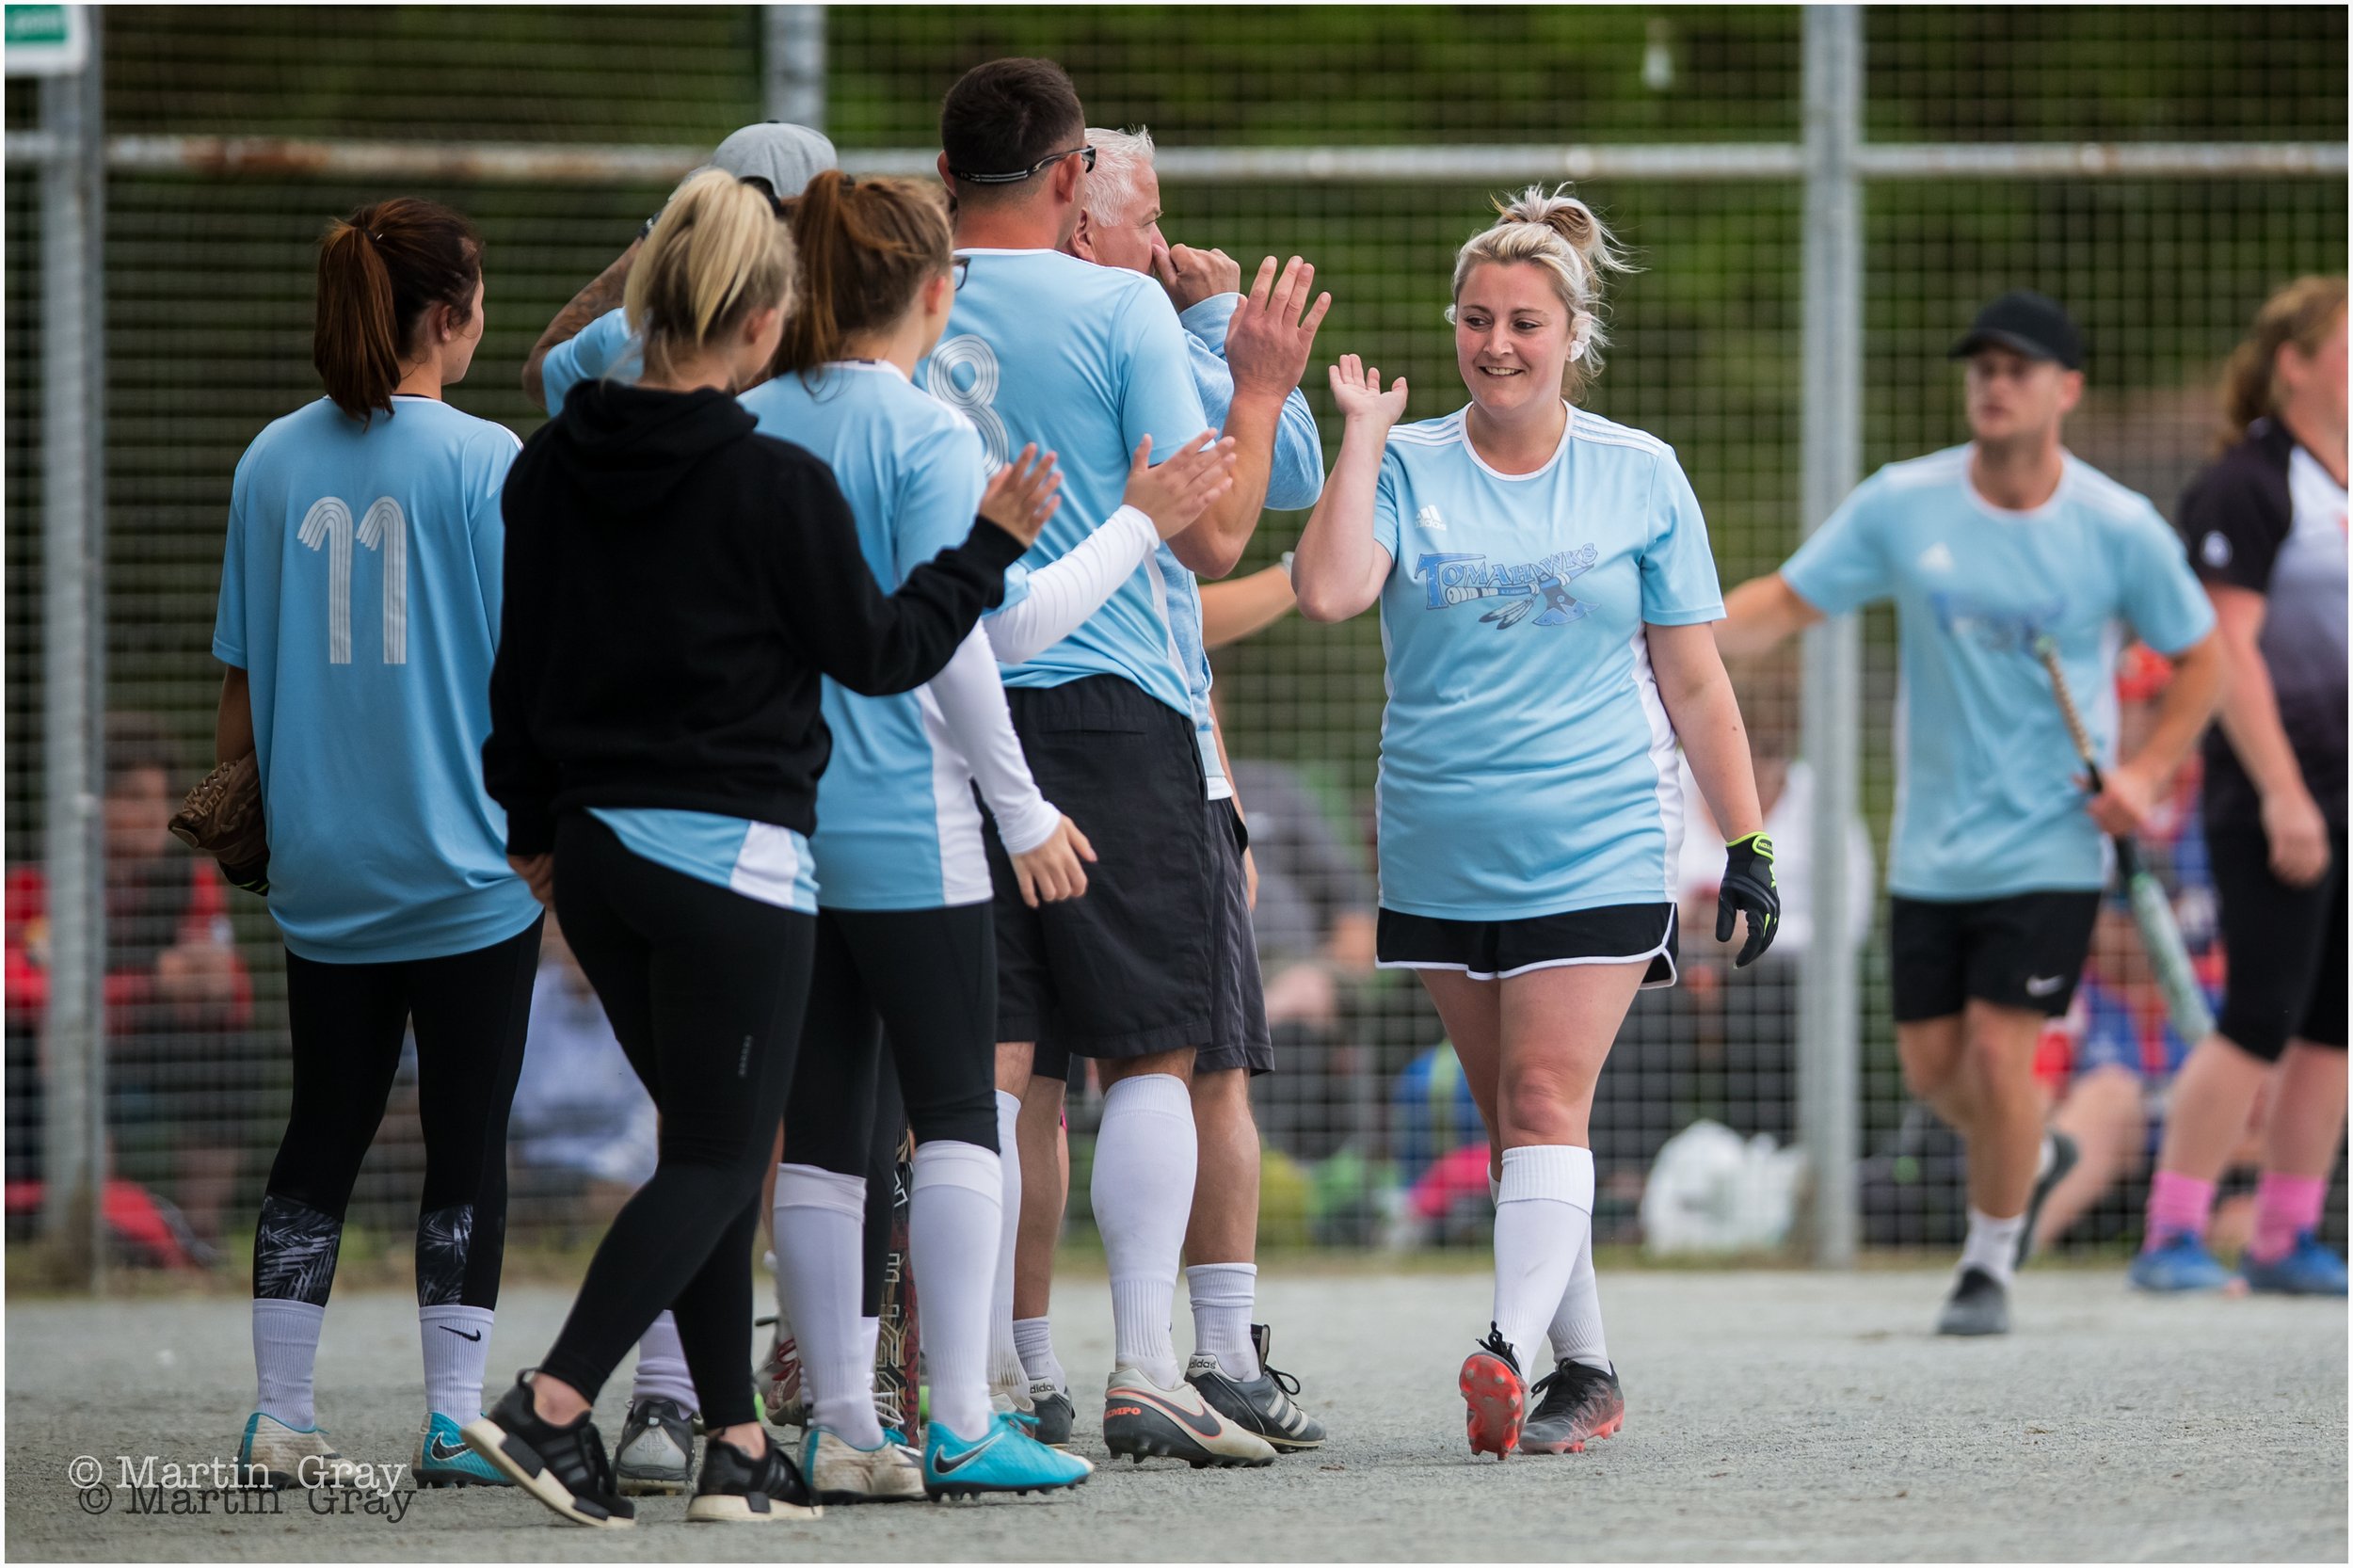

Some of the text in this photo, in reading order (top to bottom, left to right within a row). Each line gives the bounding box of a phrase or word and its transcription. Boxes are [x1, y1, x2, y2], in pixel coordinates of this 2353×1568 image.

[927, 334, 1009, 481] 8
[297, 496, 407, 664] 11
[1414, 543, 1598, 610] TOMAHAWKS
[1104, 1407, 1142, 1419] EMPO
